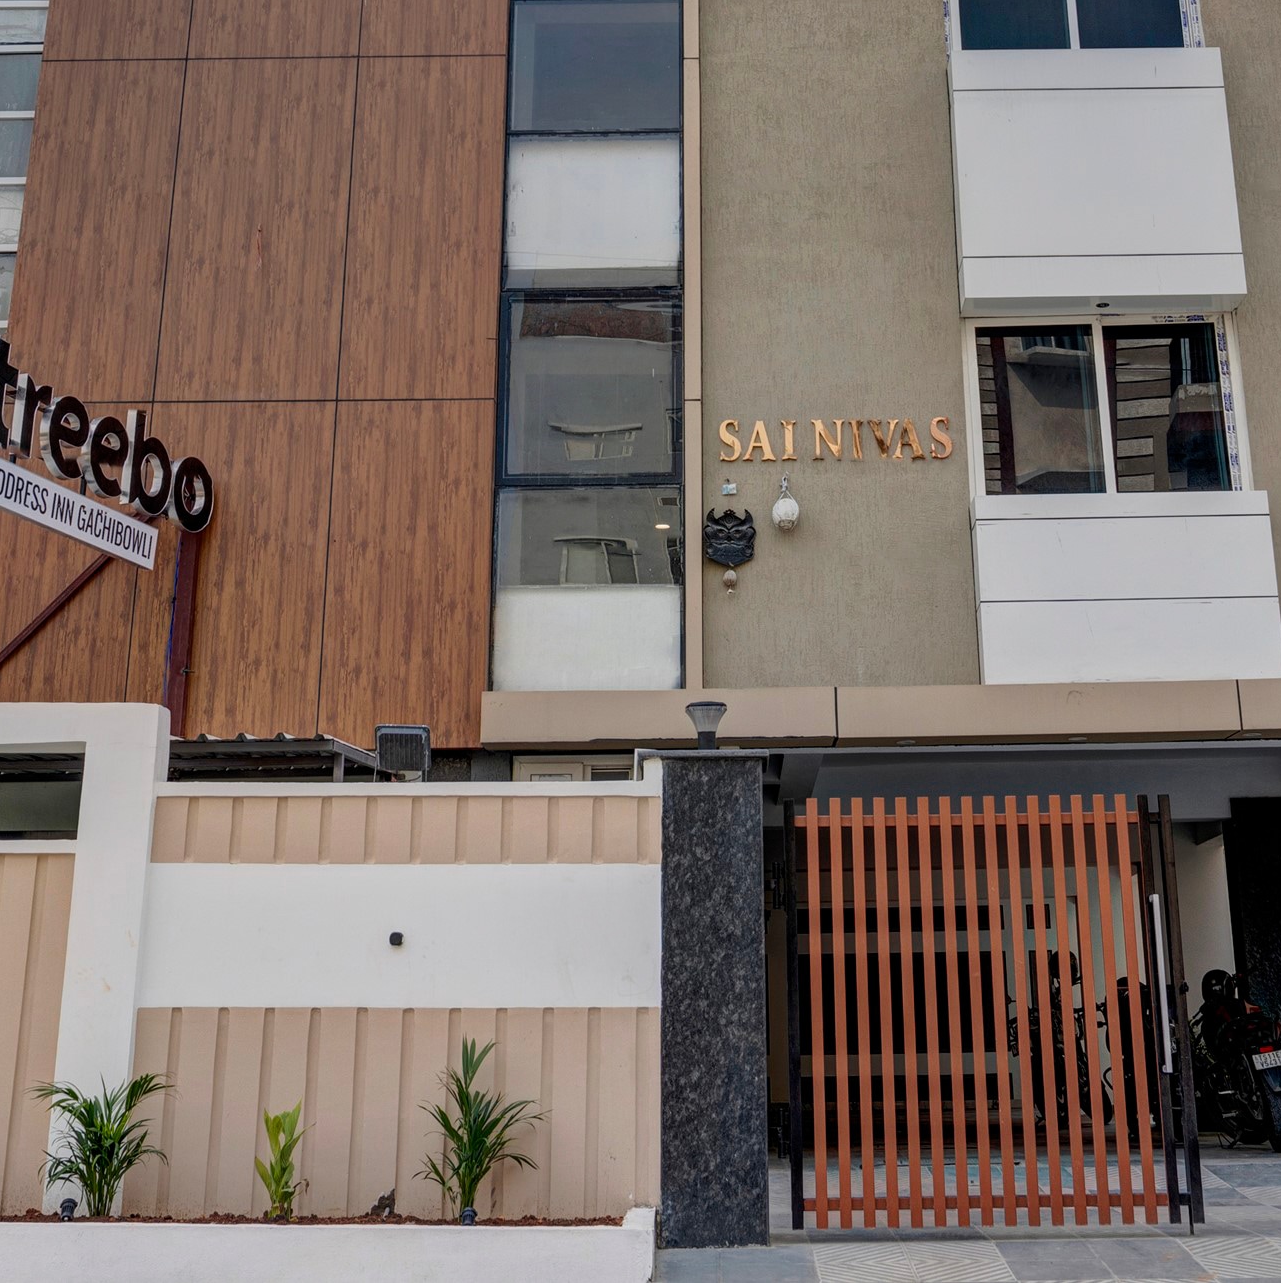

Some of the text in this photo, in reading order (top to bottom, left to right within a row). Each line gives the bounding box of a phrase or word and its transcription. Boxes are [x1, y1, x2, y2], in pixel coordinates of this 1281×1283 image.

[719, 416, 954, 462] SAI NIVAS
[51, 492, 76, 527] INN
[76, 504, 154, 560] GACHIBOWLI
